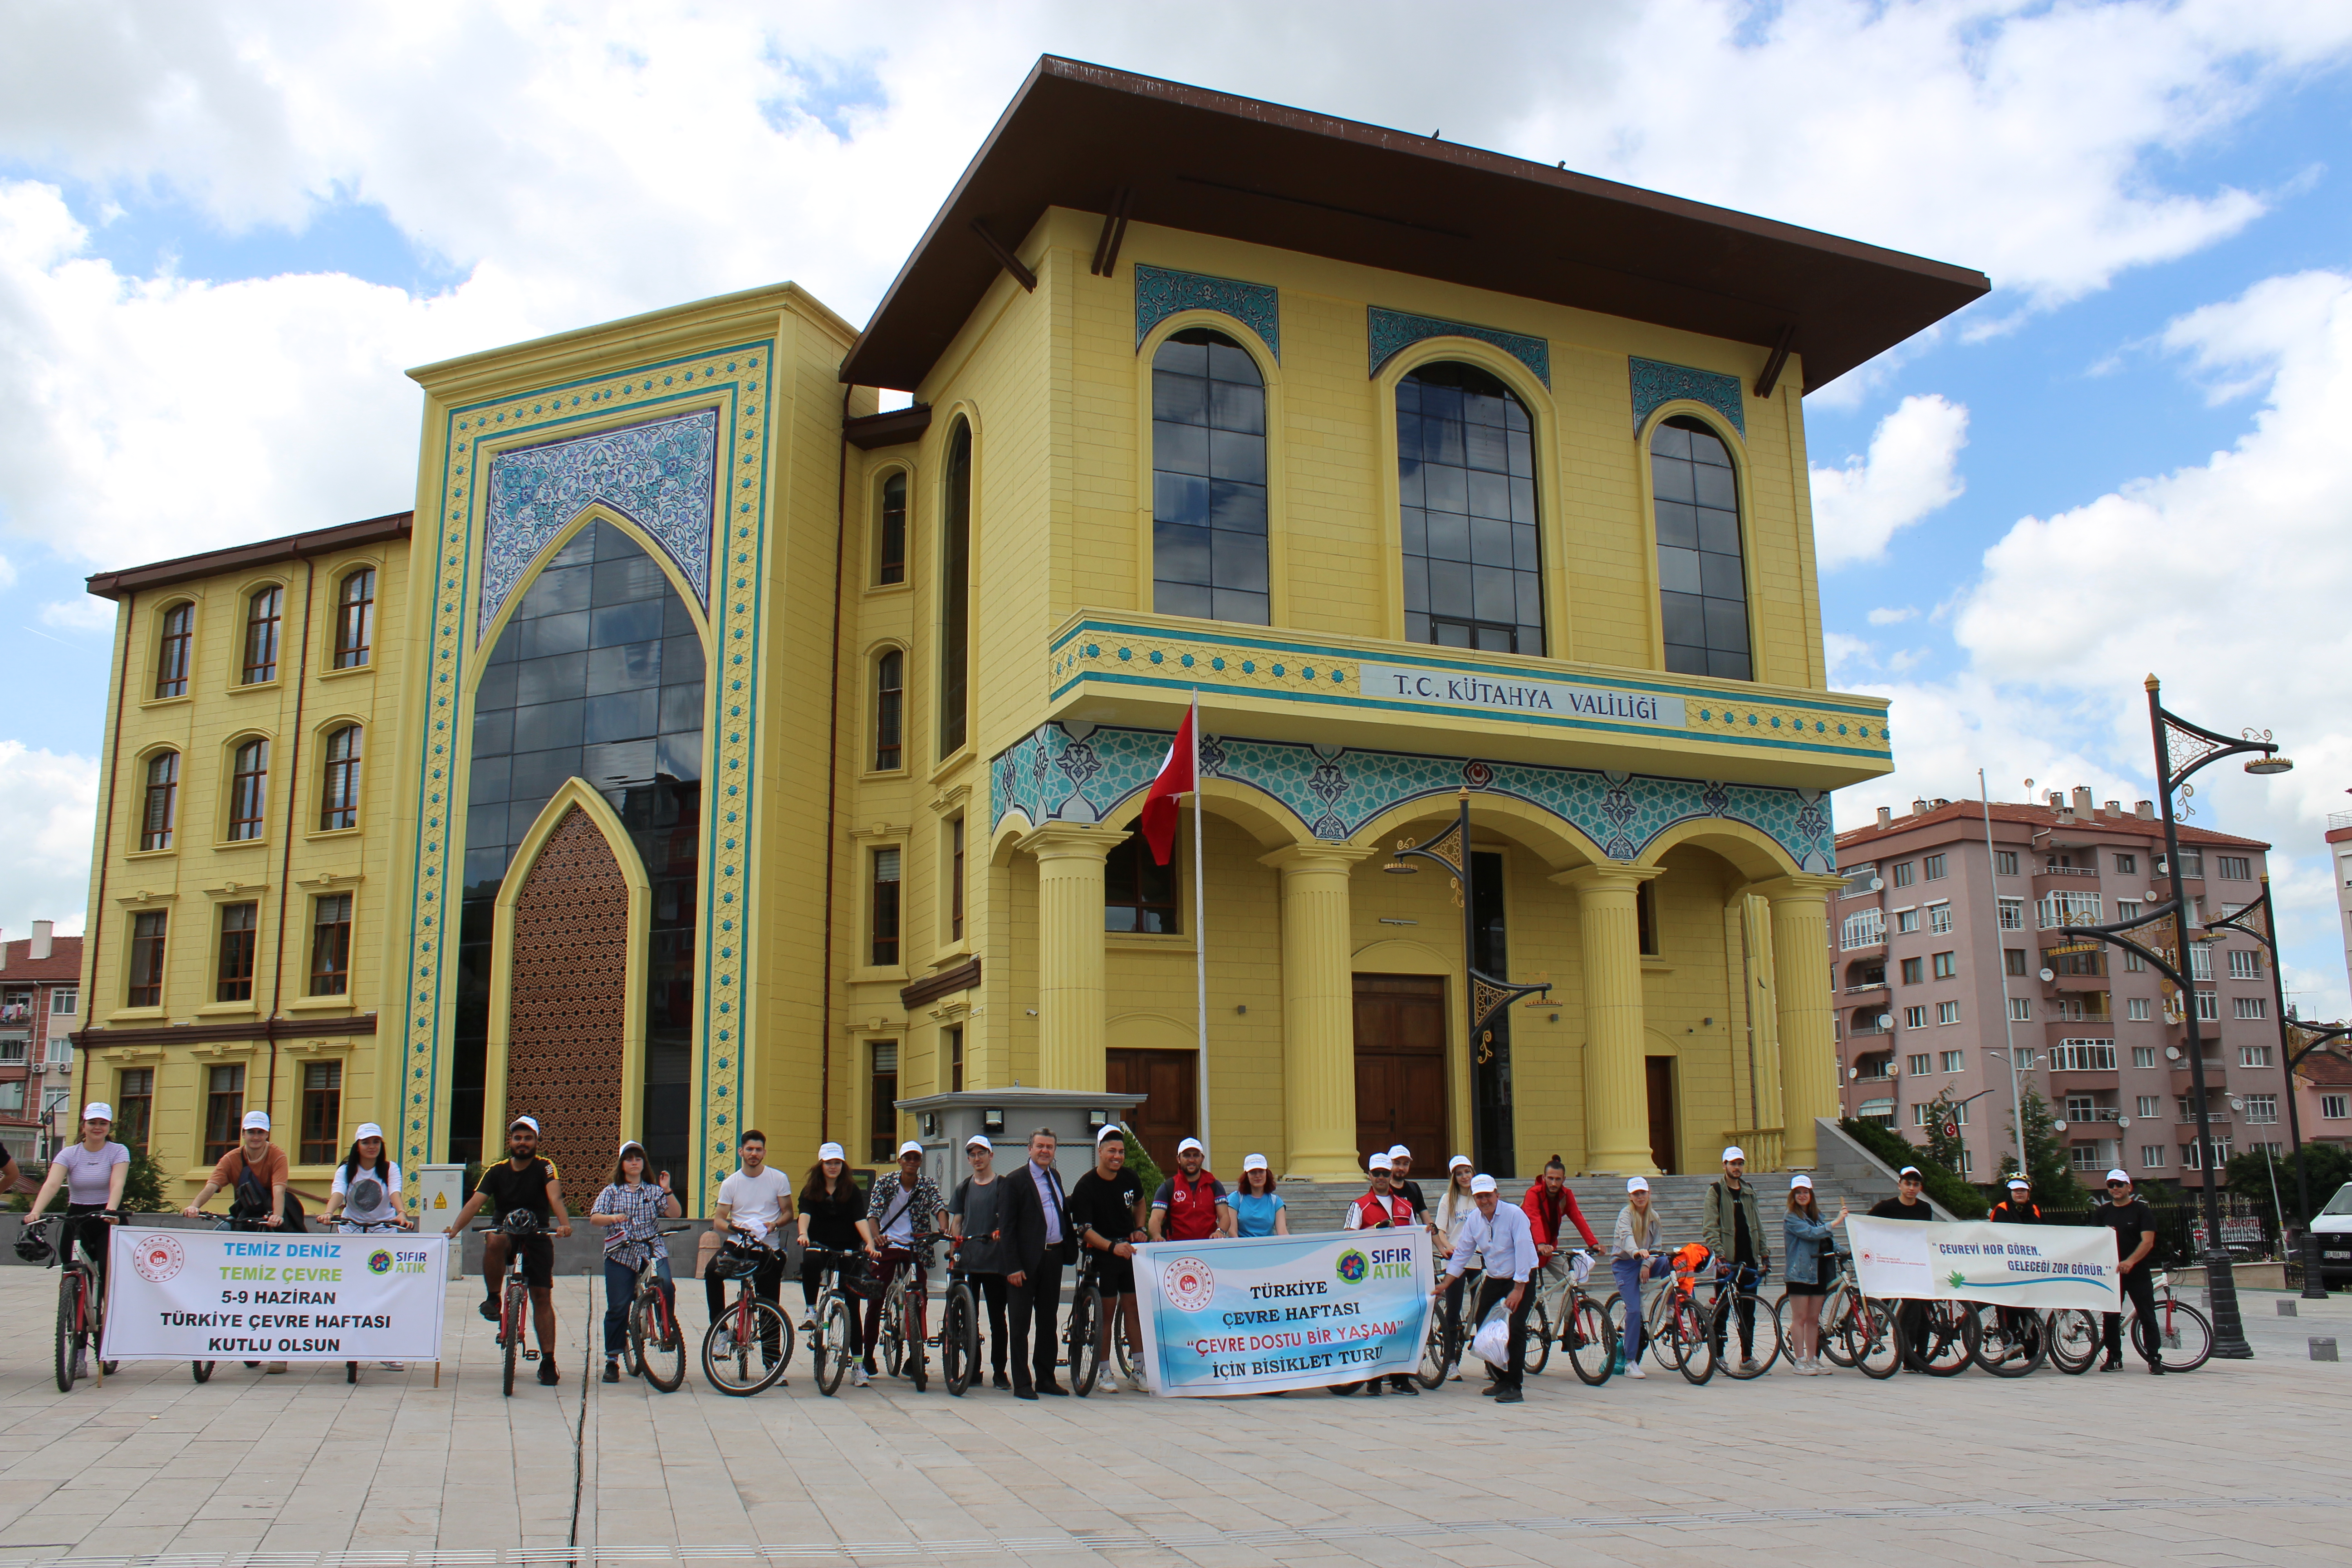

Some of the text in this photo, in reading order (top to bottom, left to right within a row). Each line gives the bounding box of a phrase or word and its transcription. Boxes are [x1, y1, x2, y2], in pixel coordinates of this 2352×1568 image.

[1447, 677, 1553, 709] KÜTAHYA
[1570, 692, 1658, 720] VALİLİĞİ
[224, 1241, 341, 1258] TEMİZ DENİZ
[396, 1252, 426, 1262] SIFIR
[1372, 1248, 1411, 1263] SIFIR
[1983, 1245, 2004, 1255] HOR
[220, 1264, 342, 1284] TEMİZ ÇEVRE
[396, 1263, 426, 1273] ATIK
[1373, 1264, 1411, 1280] ATIK
[2008, 1260, 2049, 1273] GELECEĞİ
[2052, 1263, 2068, 1274] ZOR
[221, 1289, 336, 1304] 5-9 HAZİRAN
[1250, 1280, 1327, 1299] TÜRKİYE
[160, 1310, 390, 1331] TÜRKİYE ÇEVRE HAFTASI
[1223, 1302, 1360, 1328] ÇEVRE HAFTASI
[209, 1338, 339, 1352] KUTLU OLSUN
[1253, 1333, 1301, 1350] DOSTU
[1308, 1327, 1332, 1345] BİR
[1213, 1346, 1383, 1380] İÇİN BİSİKLET TURU
